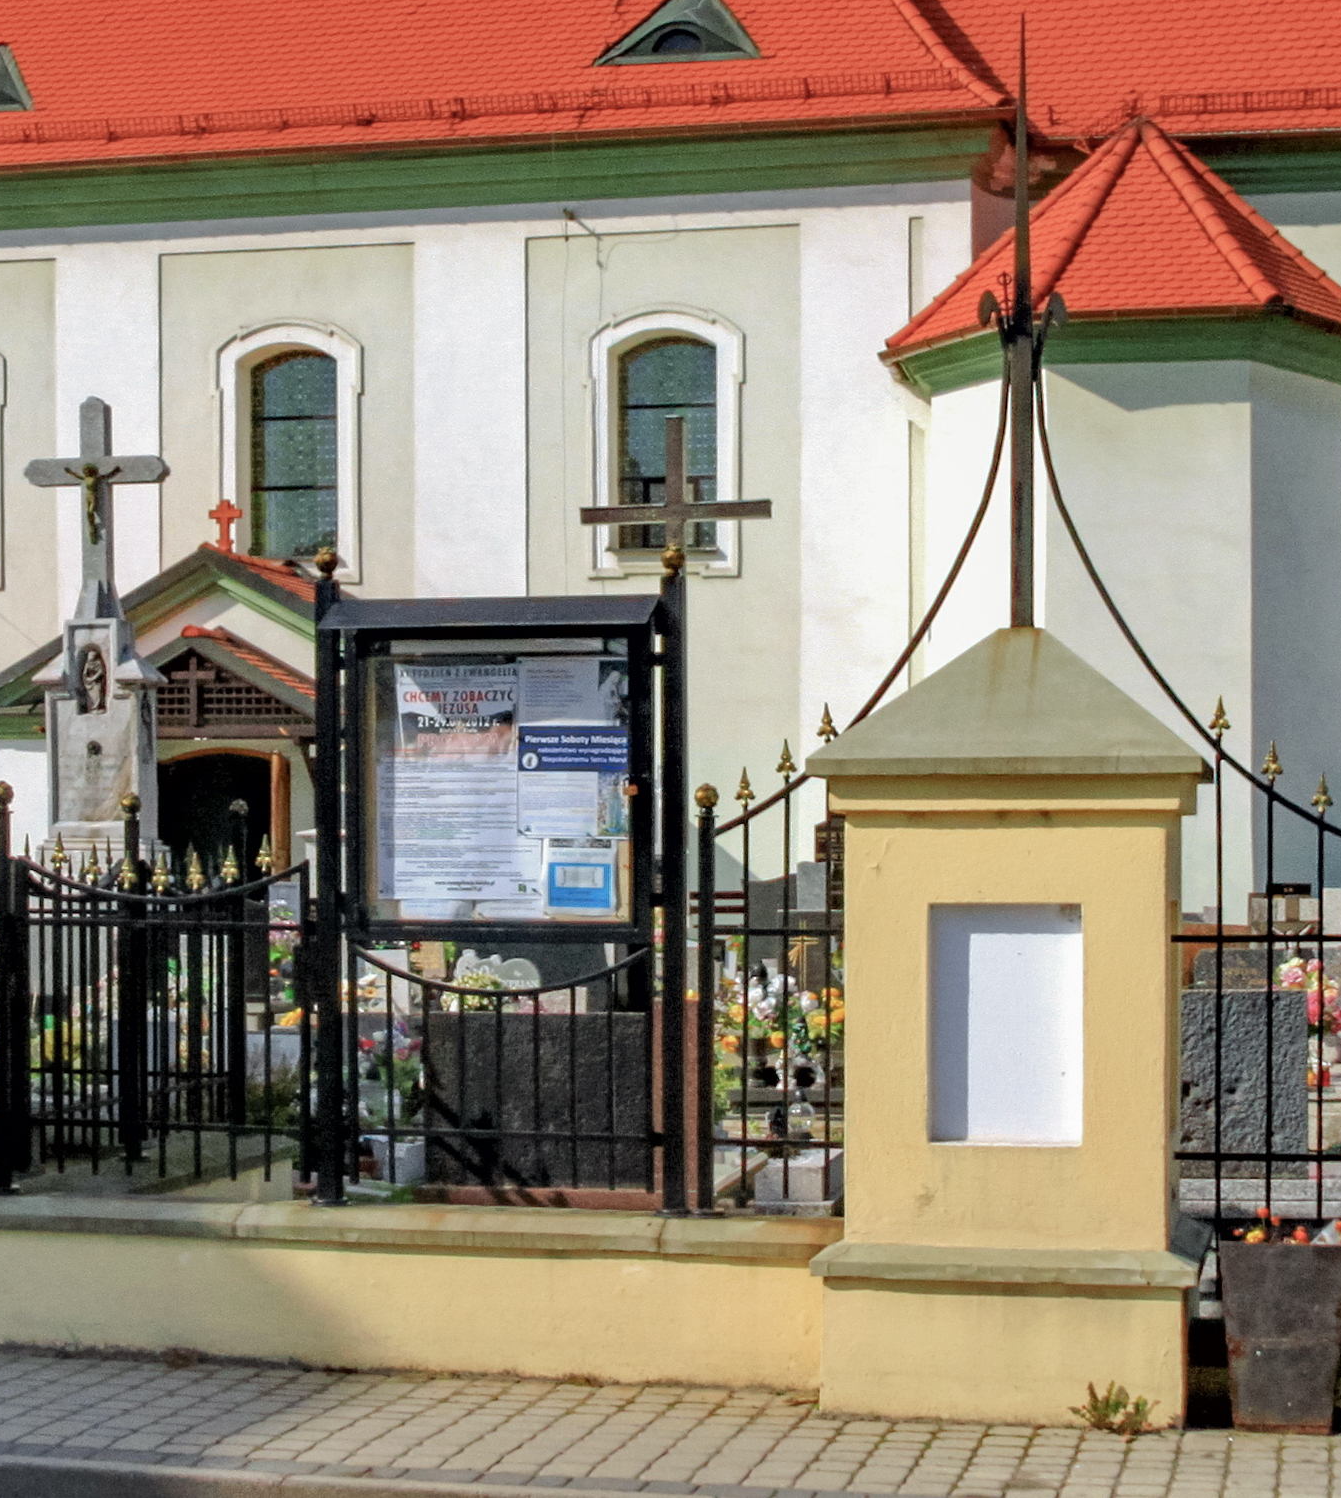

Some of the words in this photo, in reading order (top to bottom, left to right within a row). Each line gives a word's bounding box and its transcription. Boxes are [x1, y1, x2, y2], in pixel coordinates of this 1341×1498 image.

[403, 690, 448, 703] CHCEMY
[438, 703, 479, 715] JEZUSA
[525, 735, 559, 743] Pierwsze
[561, 734, 589, 745] Soboty
